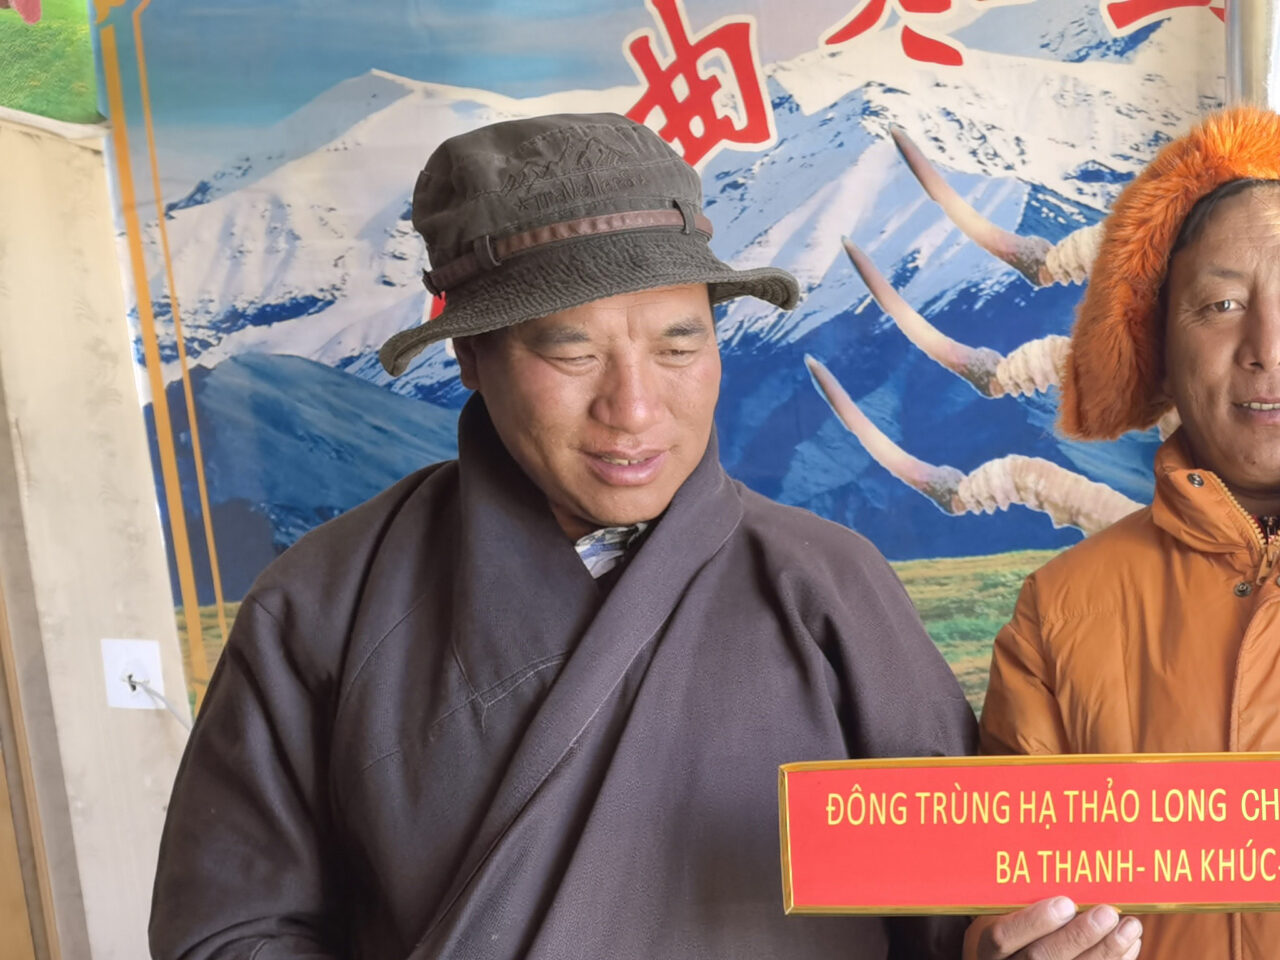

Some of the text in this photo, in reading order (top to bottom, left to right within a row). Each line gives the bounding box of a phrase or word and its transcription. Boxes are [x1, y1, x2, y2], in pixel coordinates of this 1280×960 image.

[826, 784, 907, 825] ĐÔNG
[915, 782, 1010, 824] TRÙNG
[1019, 790, 1057, 830] HẠ
[1064, 777, 1140, 823] THẢO
[1151, 788, 1227, 822] LONG
[996, 850, 1031, 884] BA
[1037, 849, 1145, 884] THANH-
[1154, 849, 1192, 882] NA
